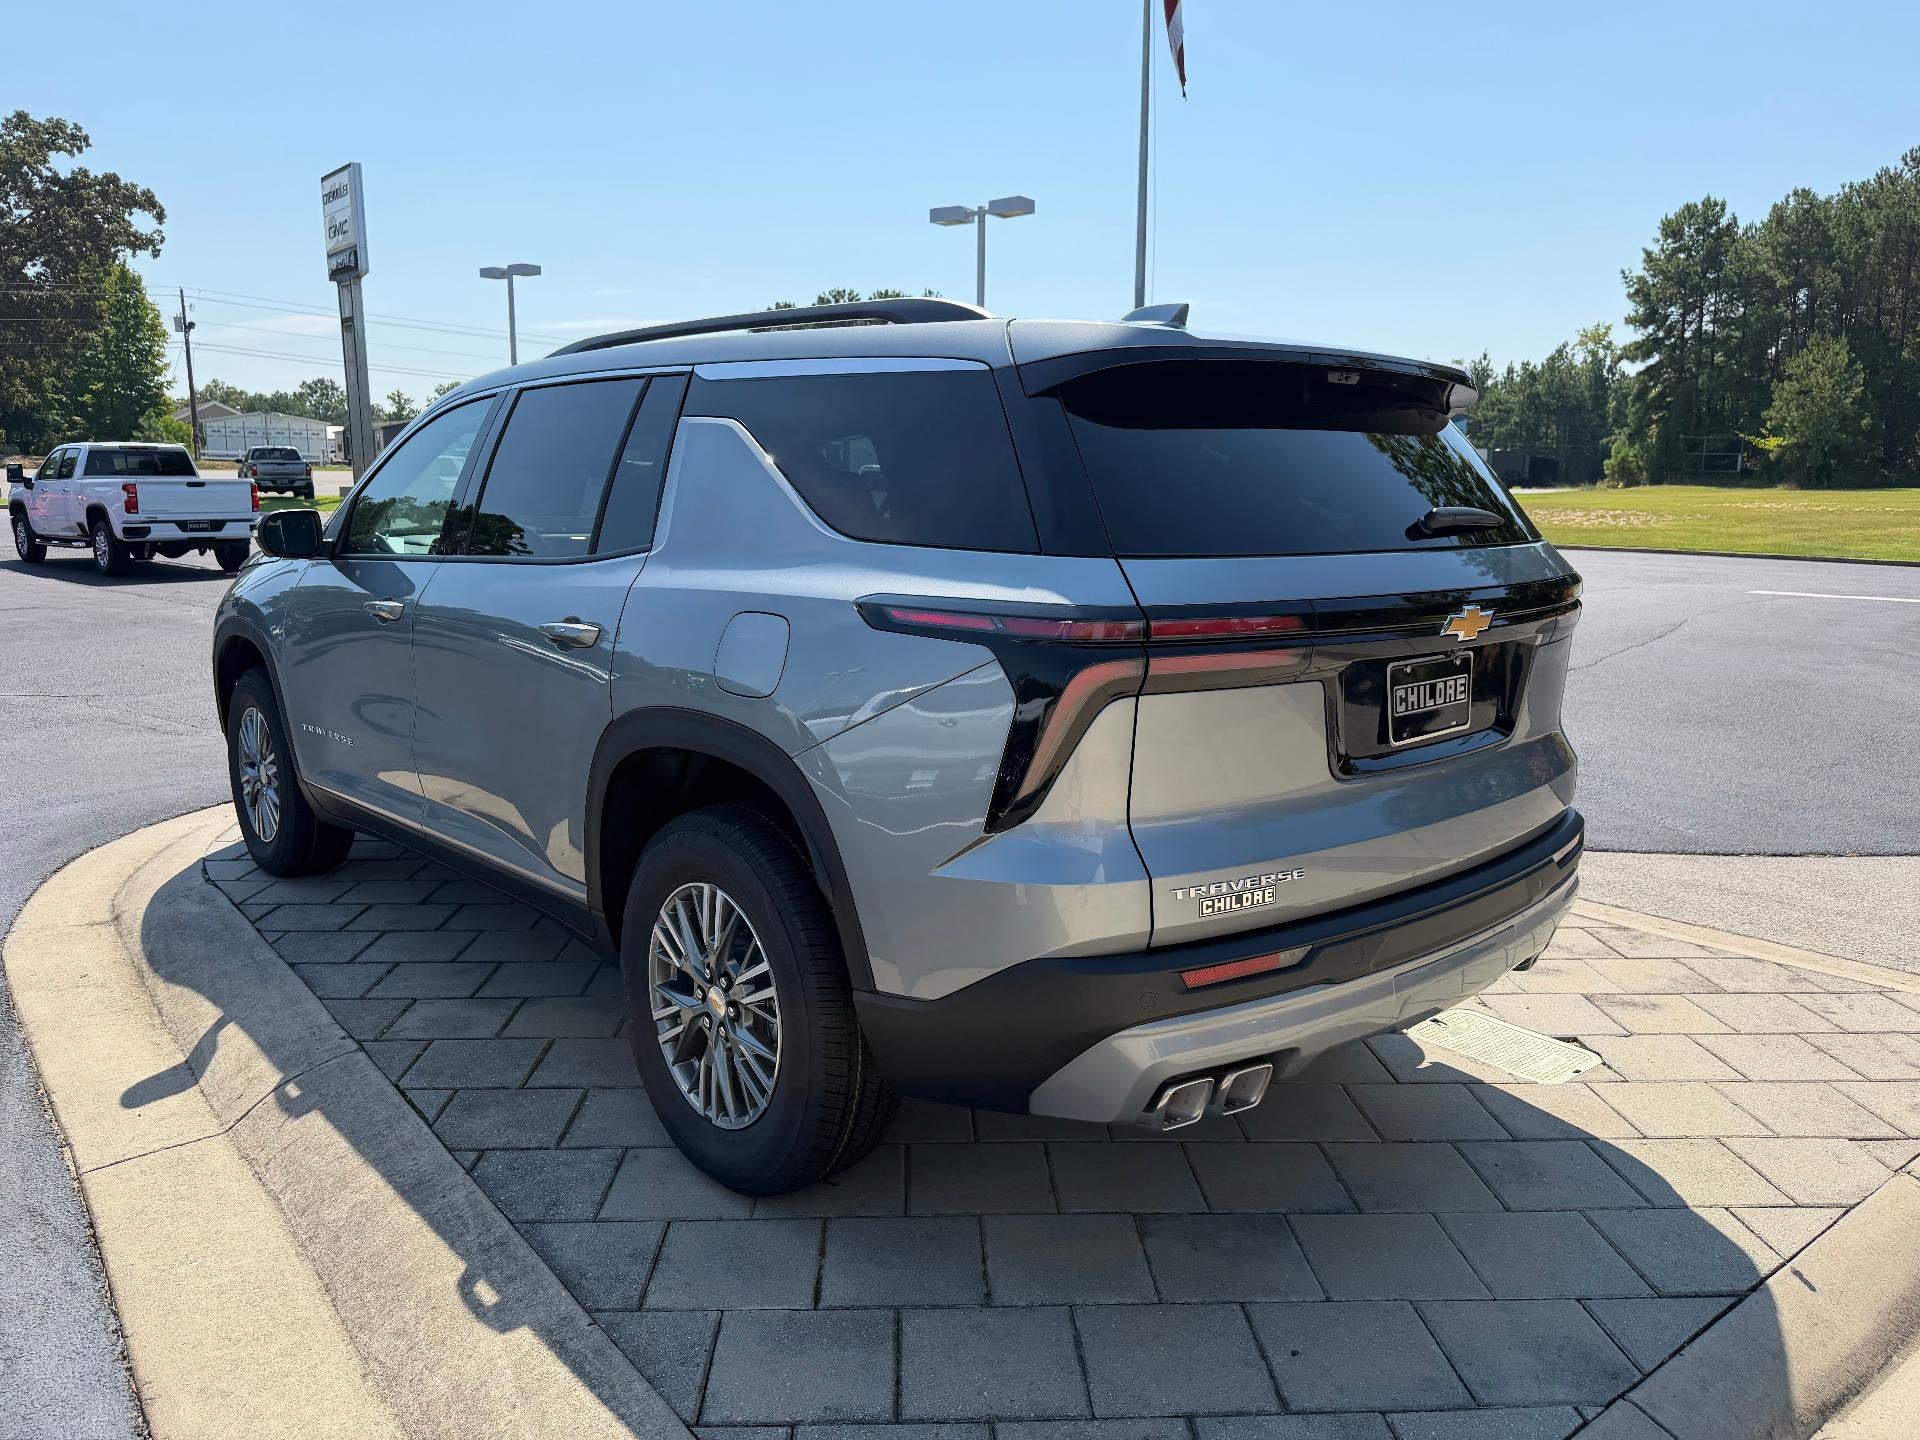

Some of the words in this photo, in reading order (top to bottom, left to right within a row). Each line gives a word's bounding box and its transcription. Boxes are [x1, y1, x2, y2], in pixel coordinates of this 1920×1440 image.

[1396, 678, 1466, 713] CHILDRE
[301, 723, 354, 747] TRAVERSE
[1170, 867, 1306, 900] TRAVERSE
[1202, 888, 1274, 914] CHILDRE
